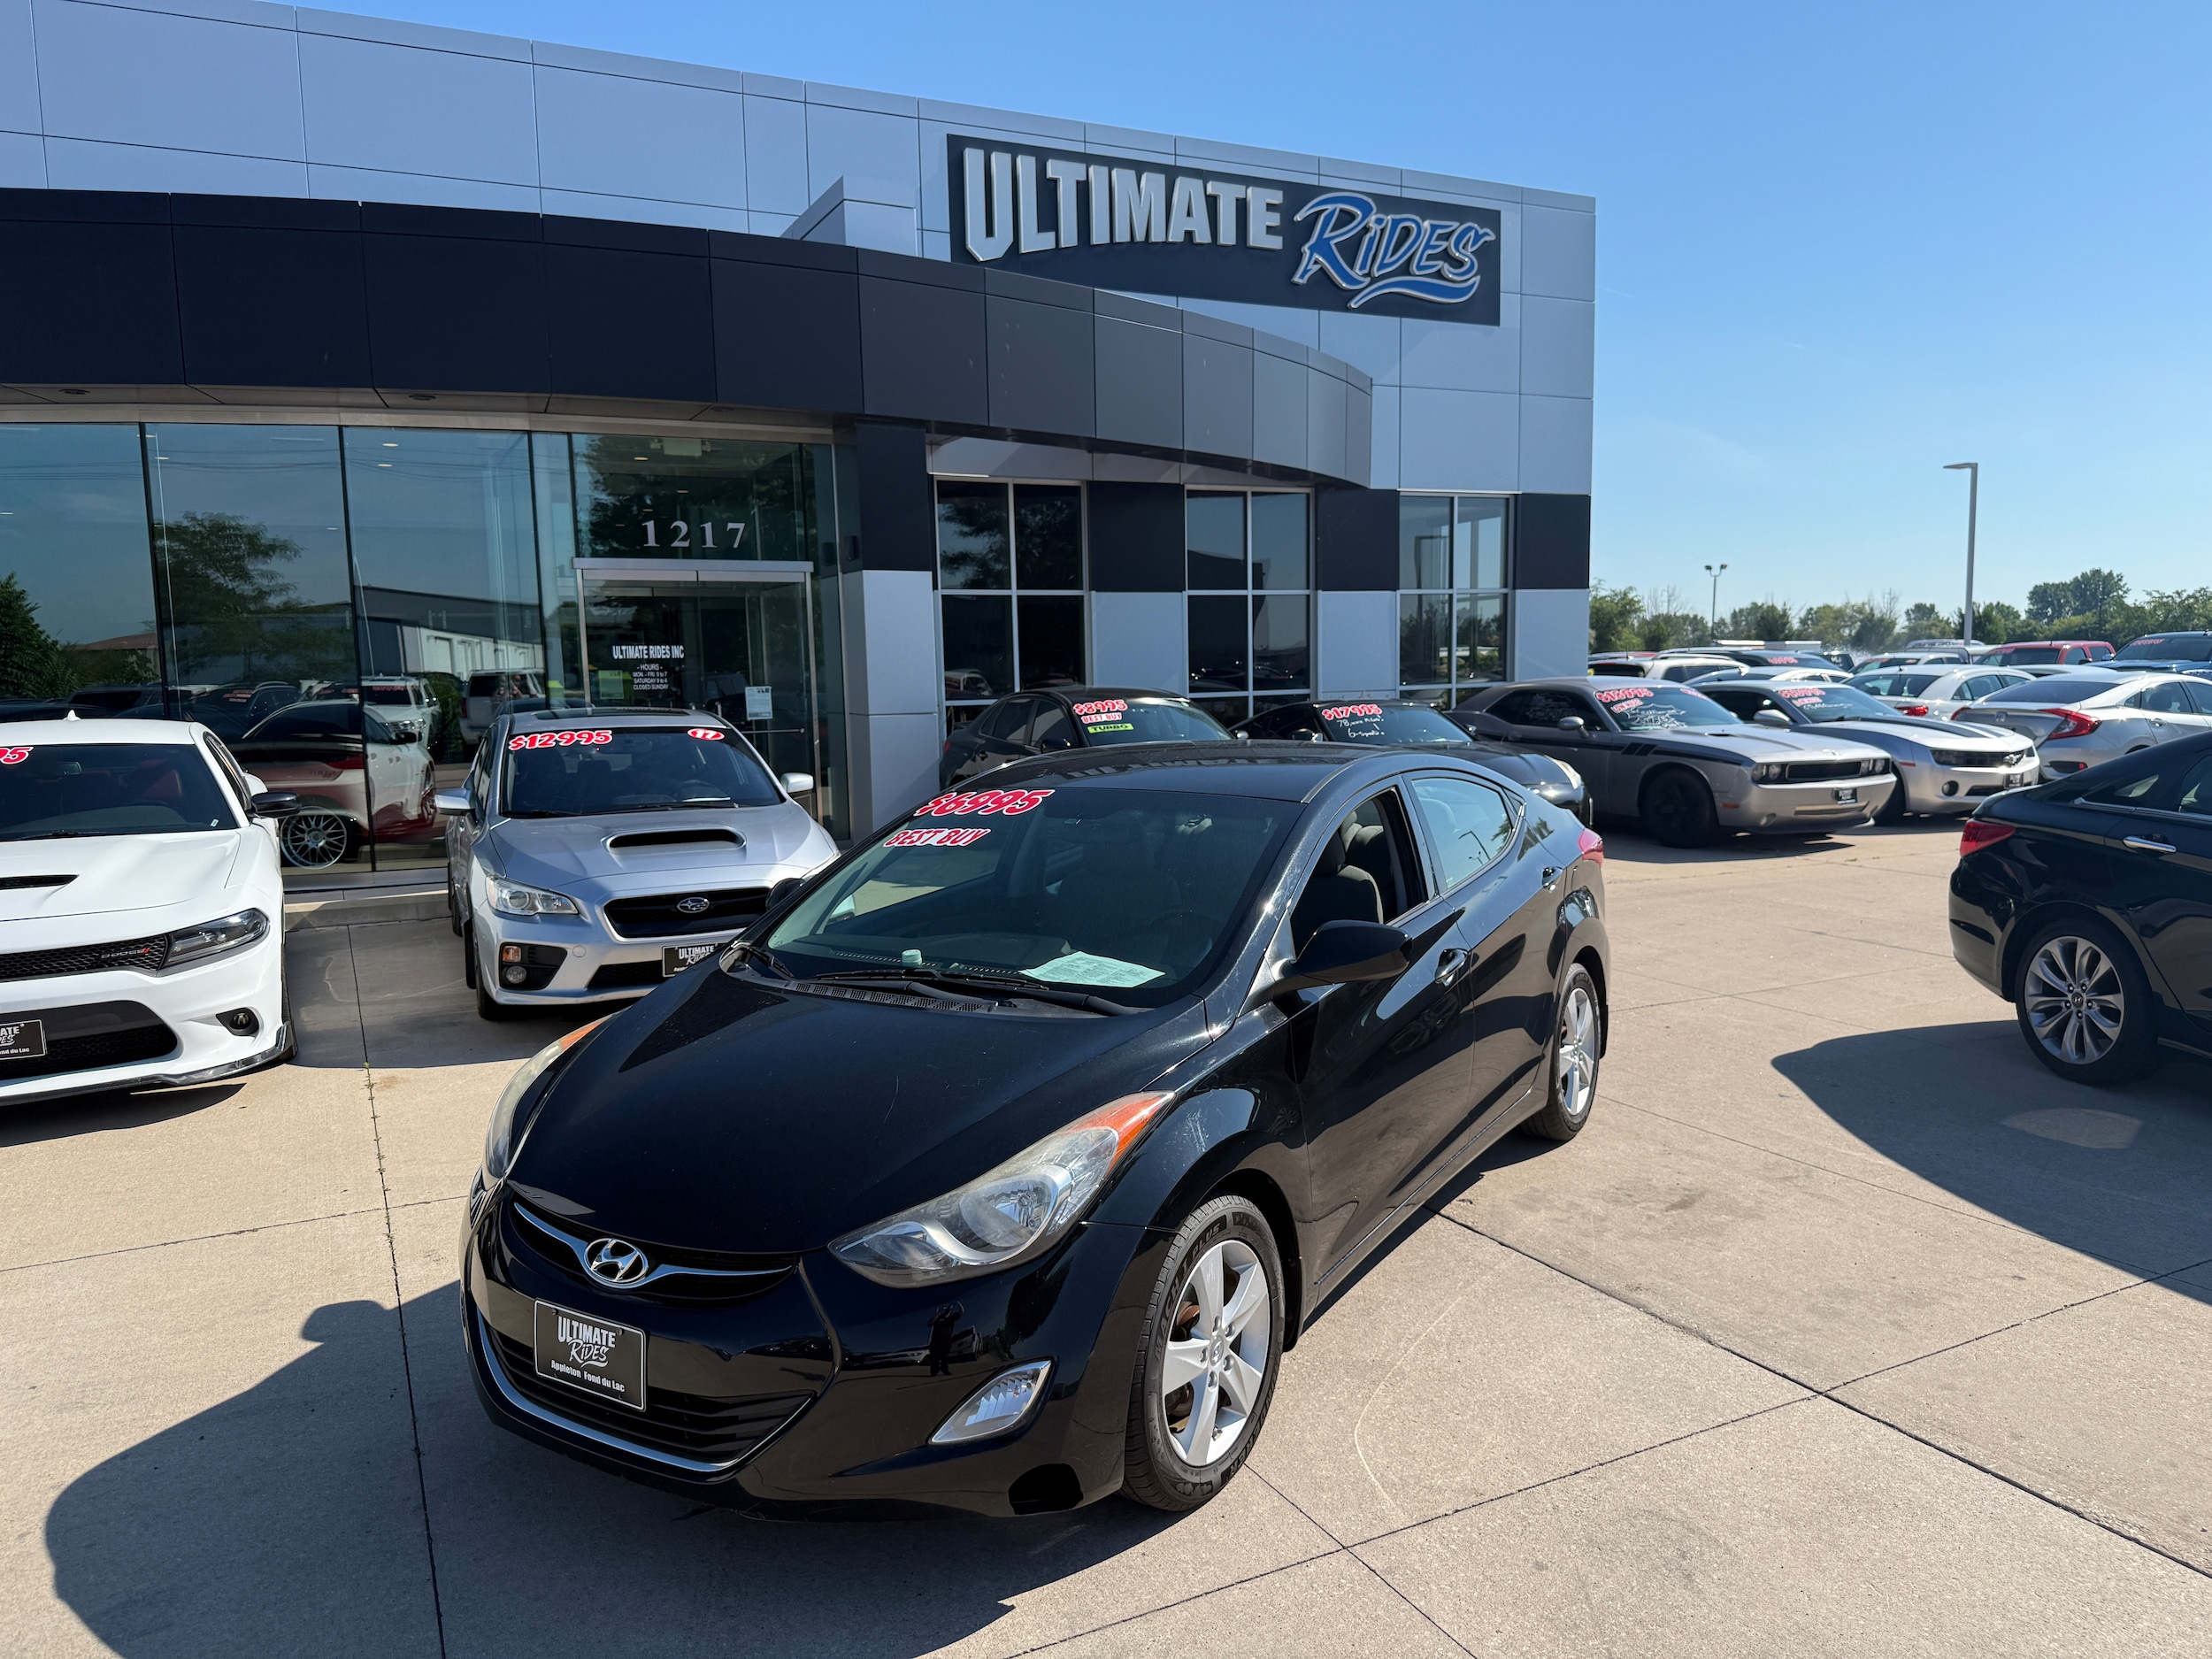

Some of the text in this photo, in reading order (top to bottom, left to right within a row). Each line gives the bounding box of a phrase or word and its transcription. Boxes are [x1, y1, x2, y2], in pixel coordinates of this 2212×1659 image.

[964, 147, 1284, 263] ULTIMATE
[641, 519, 746, 549] 1217
[612, 645, 685, 659] ULTIMATE RIDES INC
[1073, 699, 1128, 715] $8995
[1322, 703, 1383, 720] $17995
[1081, 712, 1122, 724] BEST BUY
[509, 730, 612, 750] $12995
[695, 729, 718, 740] 17
[913, 788, 1055, 817] $6995
[883, 828, 991, 847] BEST BUY
[679, 945, 714, 960] ULTIMATE
[1155, 1275, 1180, 1362] MACH
[1192, 1222, 1222, 1259] PLUS
[557, 1316, 617, 1348] ULTIMATE
[551, 1360, 626, 1393] Appleton Fond du Lac
